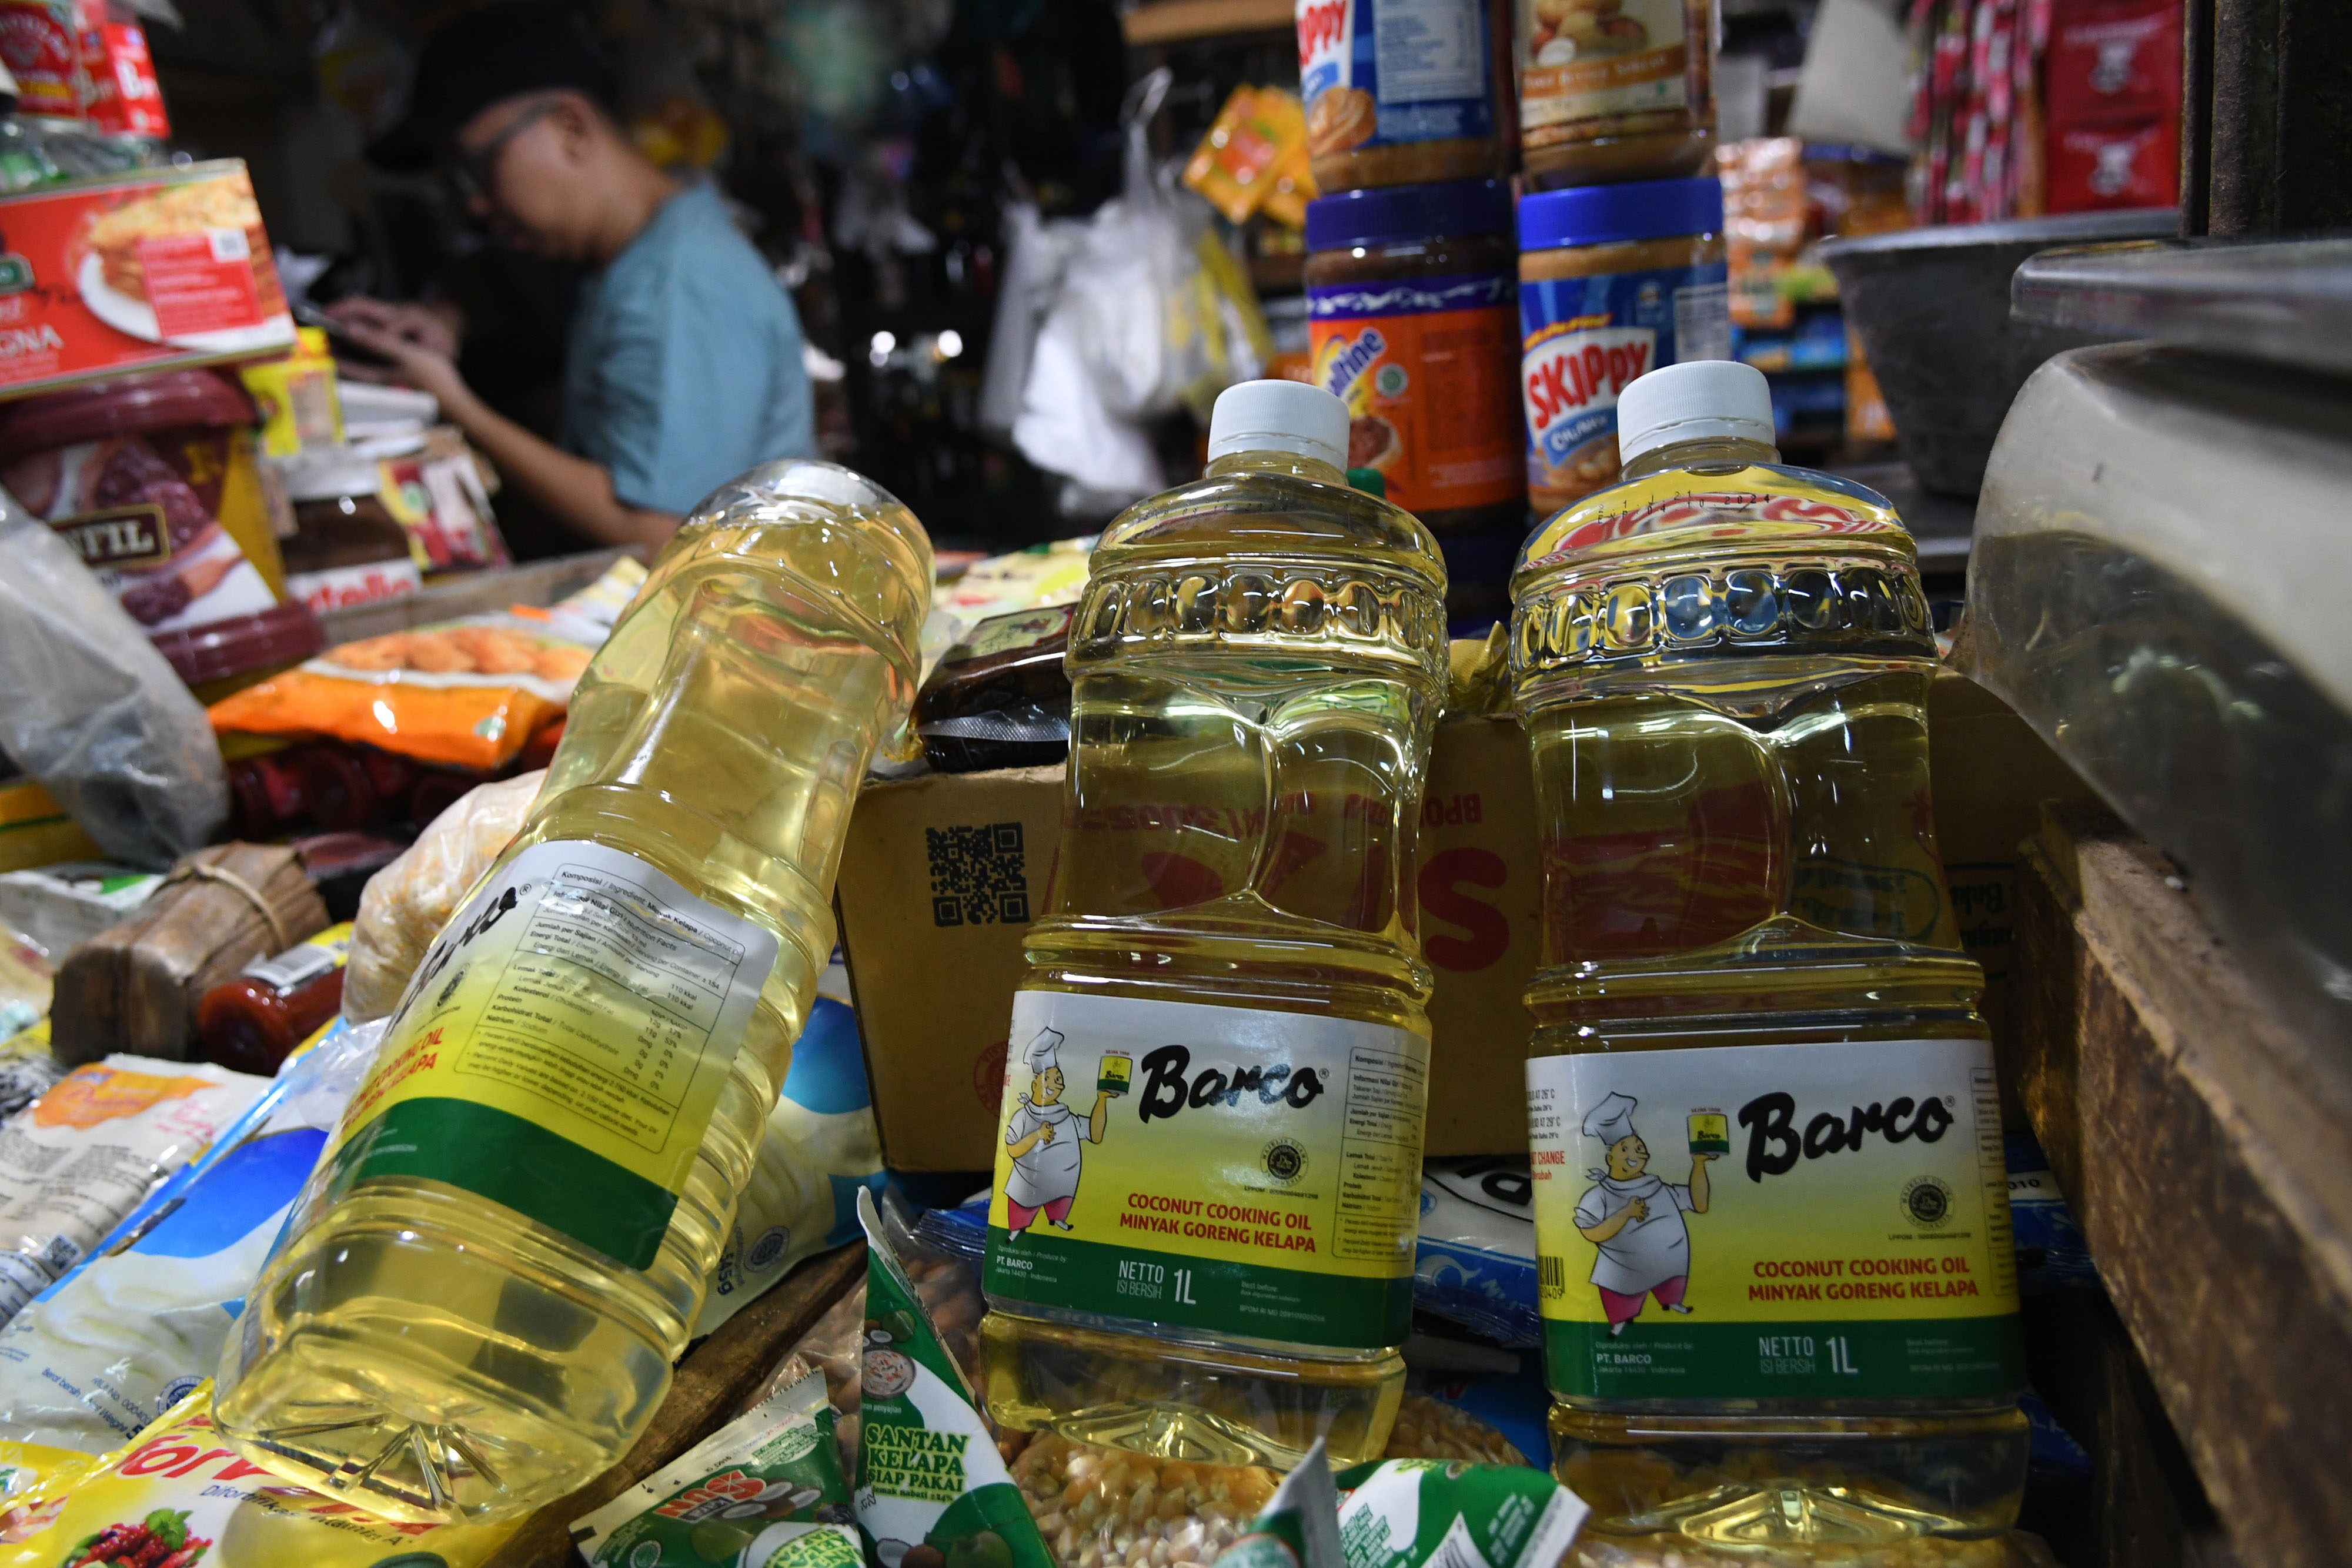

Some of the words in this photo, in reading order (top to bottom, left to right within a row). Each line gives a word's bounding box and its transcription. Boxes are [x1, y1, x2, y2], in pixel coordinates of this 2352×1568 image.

[1529, 342, 1648, 429] SKIPPY
[561, 871, 603, 885] Komposisi
[673, 917, 698, 934] Kelapa
[656, 937, 677, 951] Facts
[534, 1012, 553, 1024] Total
[1139, 1045, 1324, 1124] Barco
[1738, 1091, 1955, 1183] Barco
[1538, 1151, 1565, 1165] CHANGE
[1128, 1193, 1204, 1216] COCONUT
[1207, 1203, 1281, 1226] COOKING
[1285, 1213, 1312, 1231] OIL
[1120, 1213, 1180, 1235] MINYAK
[1183, 1222, 1250, 1245] GORENG
[1254, 1230, 1317, 1253] KELAPA
[996, 1255, 1005, 1265] PT.
[1007, 1257, 1033, 1271] BARCO
[1753, 1259, 1843, 1278] COCONUT
[1849, 1258, 1937, 1277] COOKING
[1941, 1256, 1970, 1274] OIL
[1117, 1279, 1129, 1293] ISI
[1129, 1281, 1162, 1299] BERSIH
[1119, 1259, 1164, 1283] NETTO
[1174, 1268, 1197, 1305] 1L
[1749, 1284, 1822, 1301] MINYAK
[1826, 1282, 1905, 1300] GORENG
[1910, 1279, 1979, 1298] KELAPA
[1596, 1353, 1612, 1363] PT.
[1614, 1353, 1651, 1364] BARCO
[1758, 1336, 1814, 1357] NETTO
[1825, 1336, 1859, 1375] 1L
[1760, 1358, 1775, 1374] ISI
[1775, 1358, 1816, 1375] BERSIH
[1651, 1366, 1685, 1375] Indonesia
[866, 1425, 969, 1455] SANTAN
[868, 1447, 965, 1476] KELAPA
[868, 1469, 906, 1486] SIAP
[908, 1473, 964, 1492] PAKAI
[900, 1488, 928, 1499] nabati
